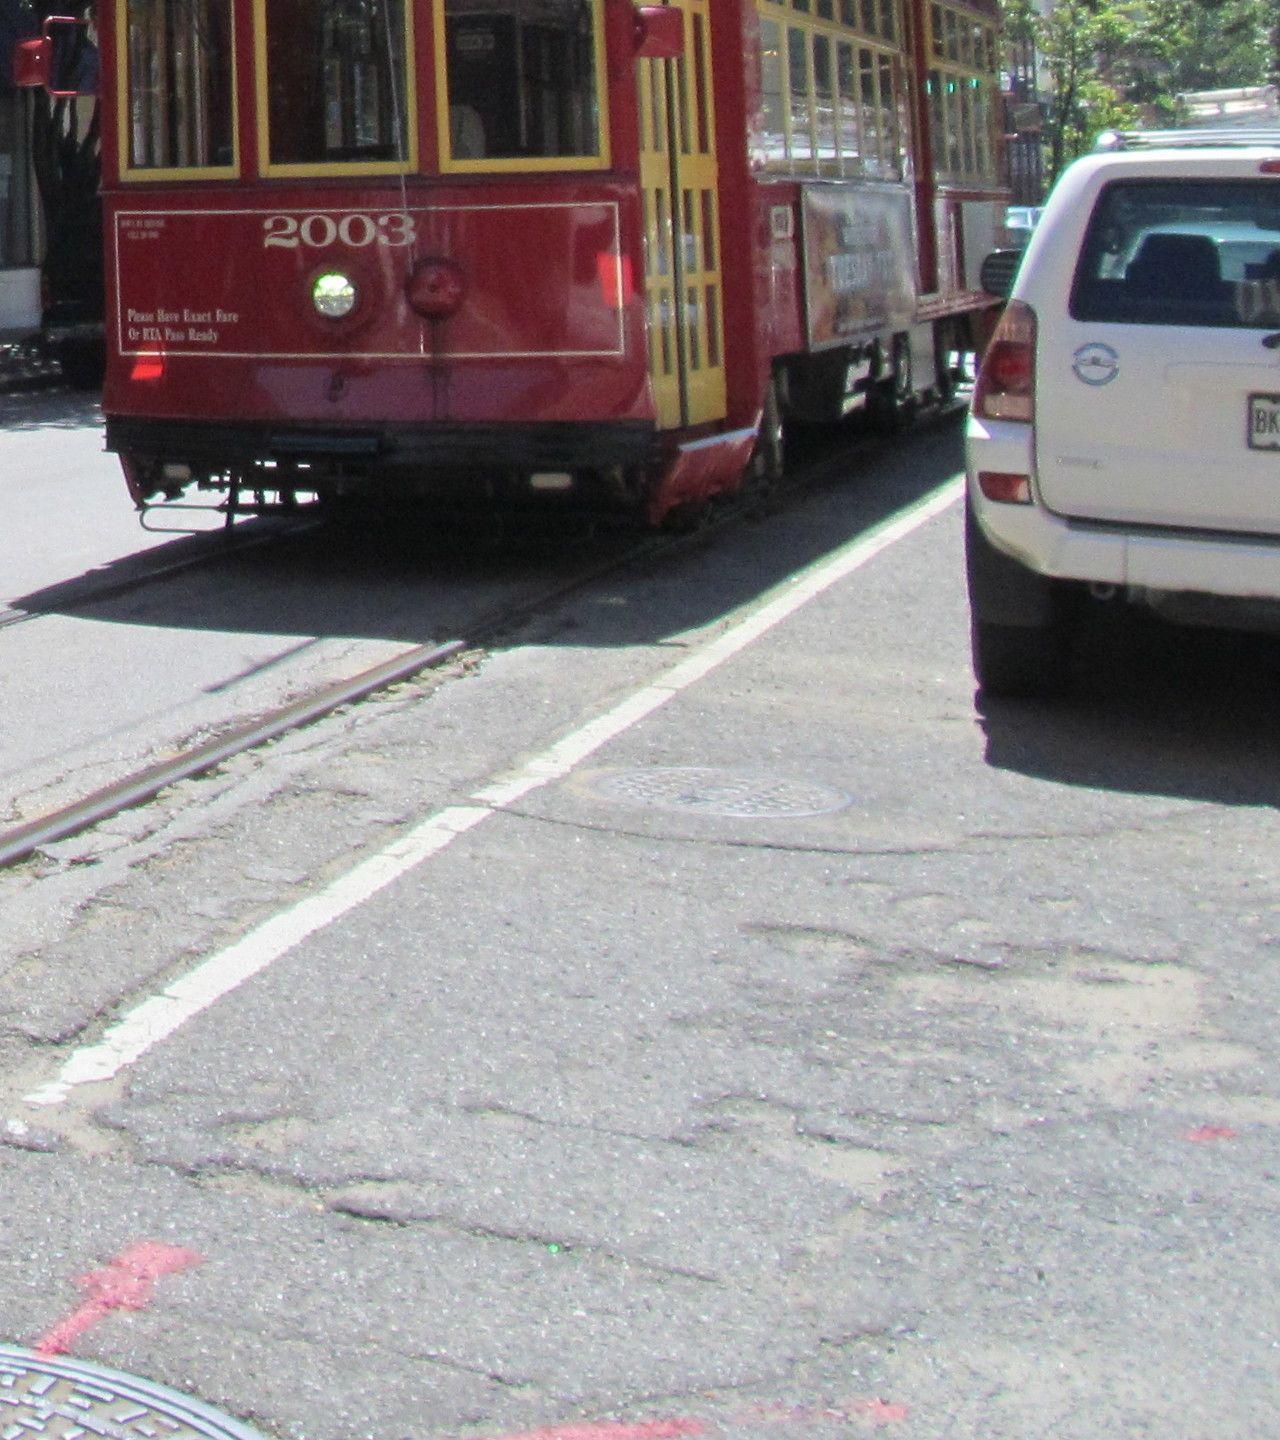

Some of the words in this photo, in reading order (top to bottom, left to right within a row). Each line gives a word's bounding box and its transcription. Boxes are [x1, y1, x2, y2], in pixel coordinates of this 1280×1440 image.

[262, 213, 417, 249] 2003
[157, 308, 180, 322] Have
[183, 308, 212, 322] Exact
[215, 308, 240, 322] Fare
[128, 327, 140, 340] Or
[142, 327, 162, 340] RTA
[165, 327, 186, 341] Pass
[188, 327, 218, 343] Ready
